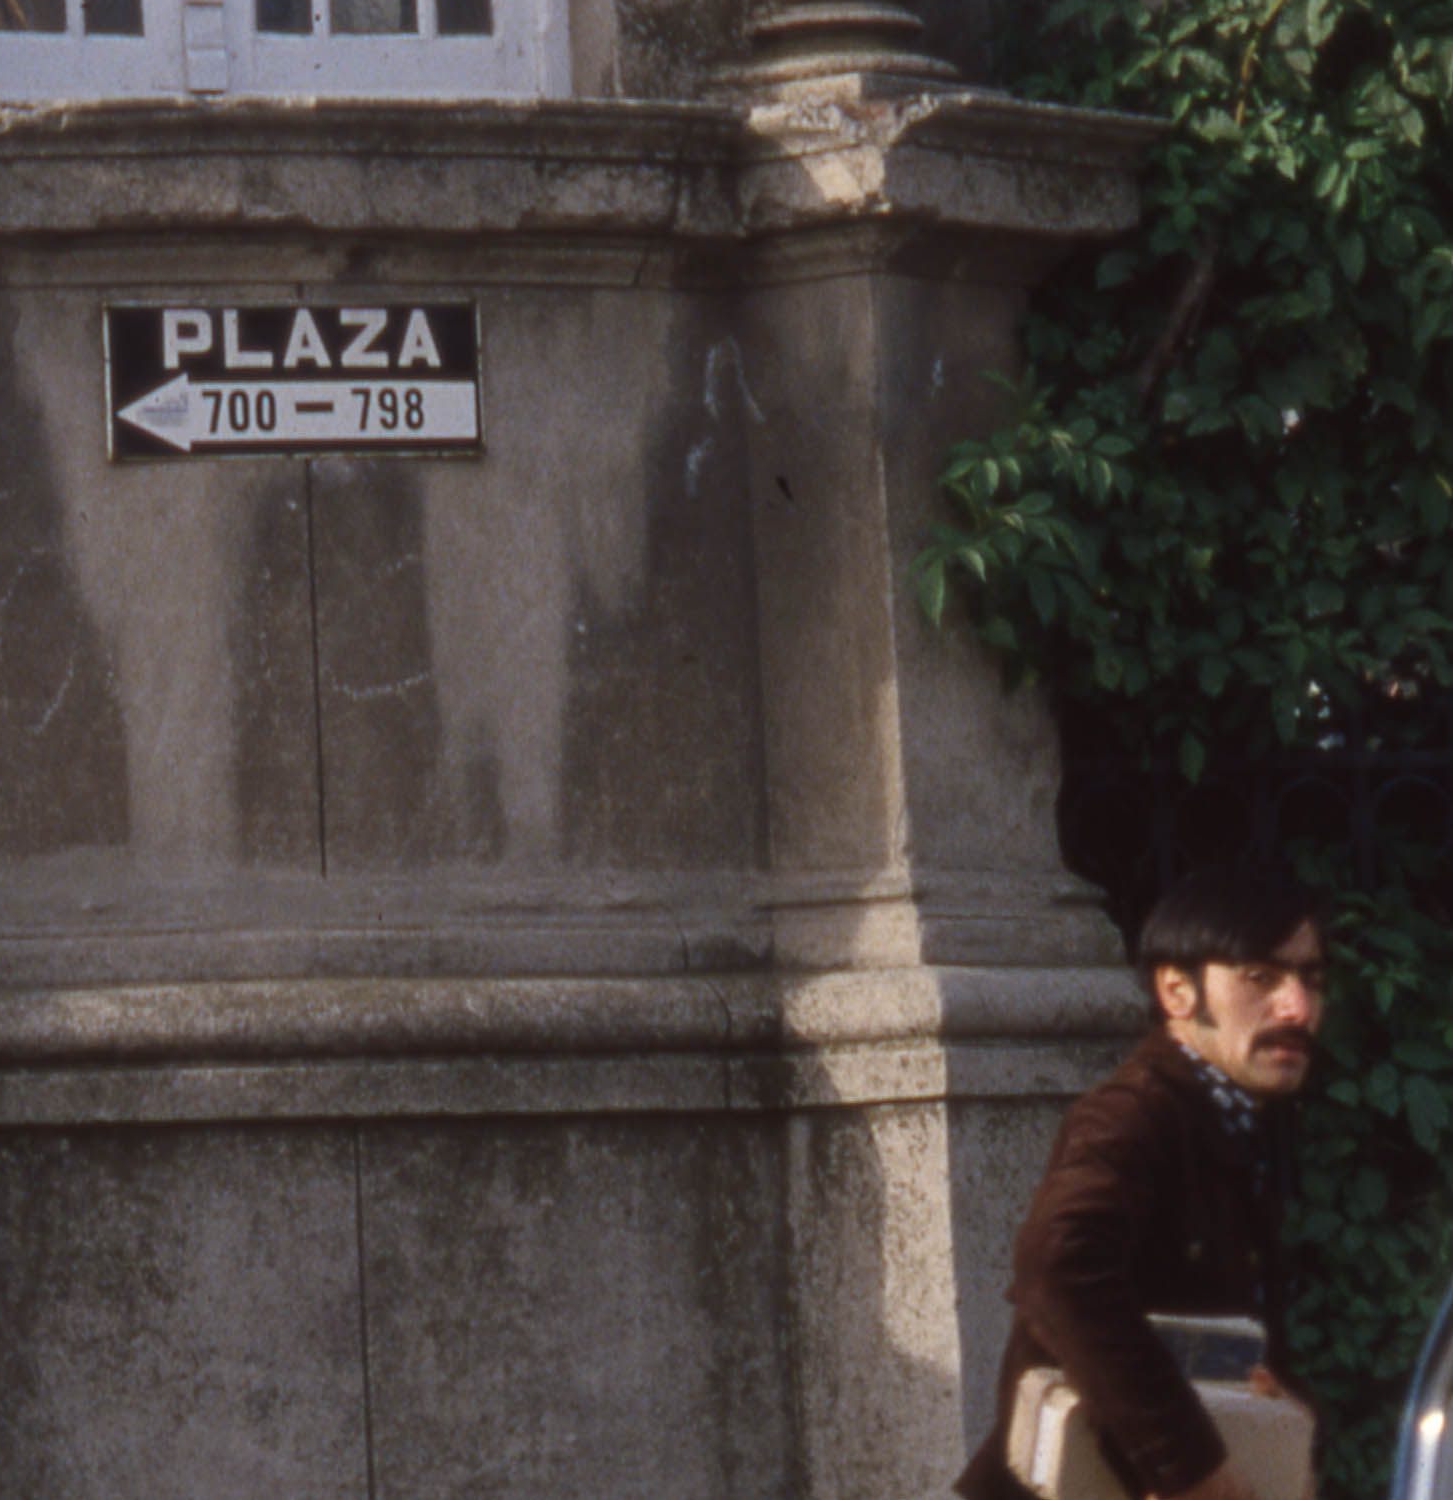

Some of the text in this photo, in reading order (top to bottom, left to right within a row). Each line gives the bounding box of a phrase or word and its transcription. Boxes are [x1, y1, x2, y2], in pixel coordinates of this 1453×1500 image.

[162, 308, 441, 369] PLAZA
[202, 390, 277, 433] 700
[351, 387, 425, 430] 798
